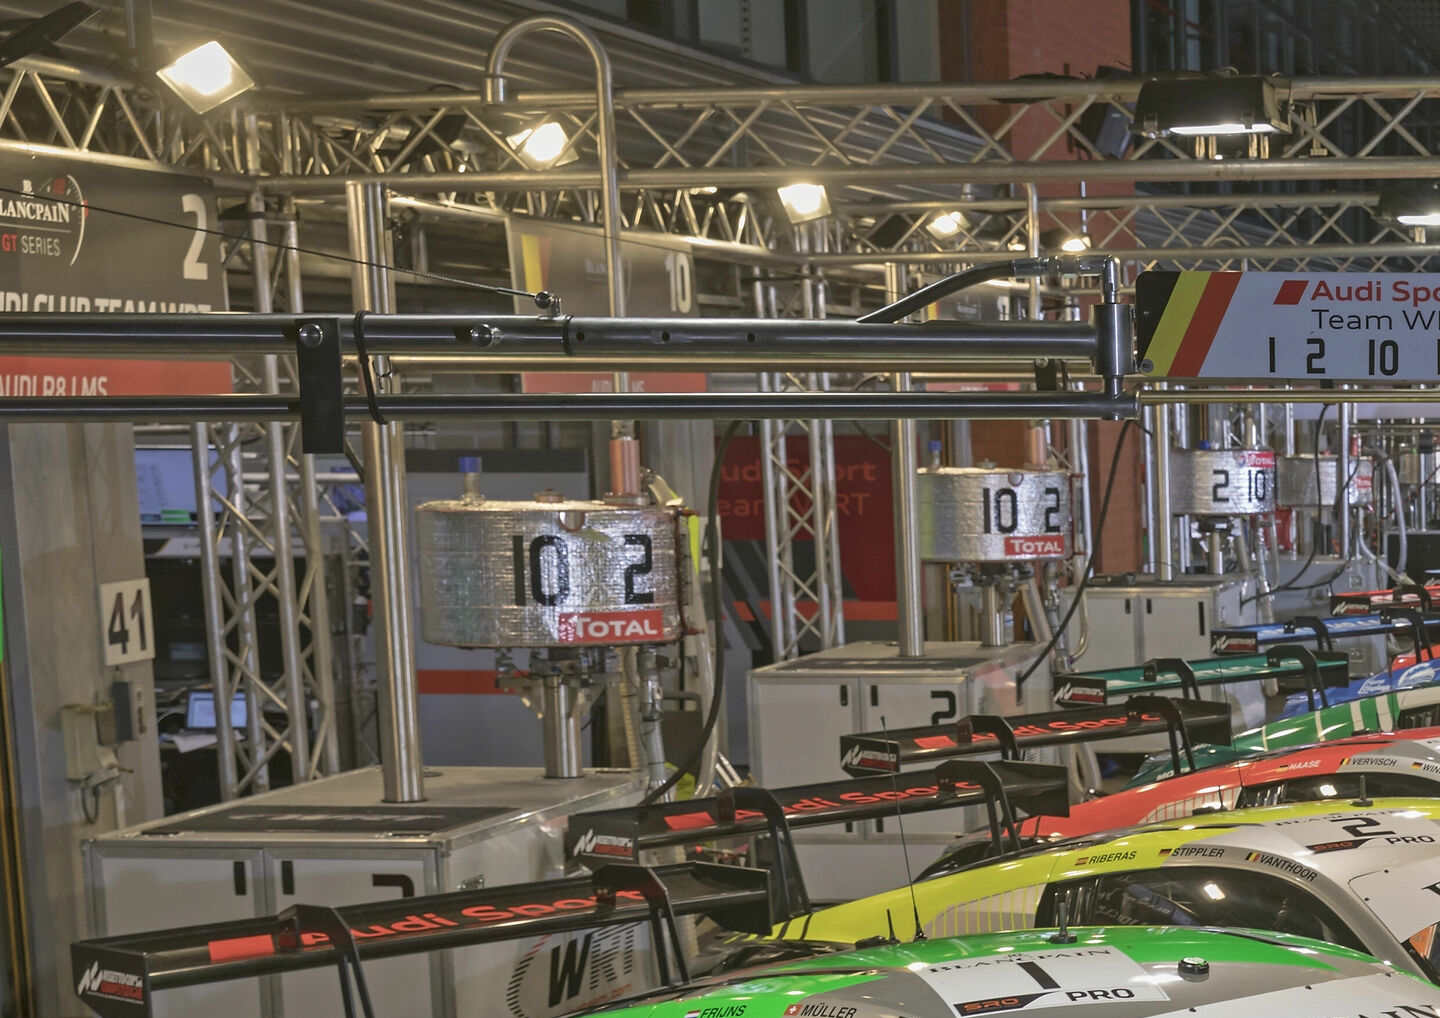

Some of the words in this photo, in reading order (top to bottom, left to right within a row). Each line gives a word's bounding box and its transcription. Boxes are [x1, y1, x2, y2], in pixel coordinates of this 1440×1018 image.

[0, 198, 70, 223] LANCPAIN
[2, 232, 17, 252] GT
[21, 235, 60, 256] SERIES
[182, 194, 208, 280] 2
[665, 252, 692, 314] 10
[1311, 280, 1382, 302] Audi
[1311, 309, 1392, 330] Team
[1269, 337, 1276, 373] 1
[1306, 338, 1326, 374] 2
[1368, 339, 1399, 376] 10
[72, 376, 108, 396] LMS
[1212, 469, 1230, 503] 2
[1248, 469, 1266, 503] 10
[983, 487, 1017, 535] 10
[1044, 487, 1061, 533] 2
[1010, 538, 1063, 554] TOTAL
[513, 534, 570, 607] 10
[624, 533, 654, 605] 2
[108, 588, 148, 656] 41
[568, 613, 658, 639] TOTAL
[1288, 759, 1320, 771] HAASE
[1351, 757, 1397, 767] VERVISCH
[1329, 816, 1396, 838] 2
[1385, 835, 1436, 845] PRO
[1088, 850, 1137, 865] RIBERAS
[1171, 848, 1225, 858] STIPPLER
[1260, 853, 1318, 881] VANTHOOR
[929, 948, 1112, 974] BLANCPAIN
[1016, 960, 1061, 990] 1
[963, 998, 1020, 1012] SRO
[1066, 988, 1136, 1002] PRO
